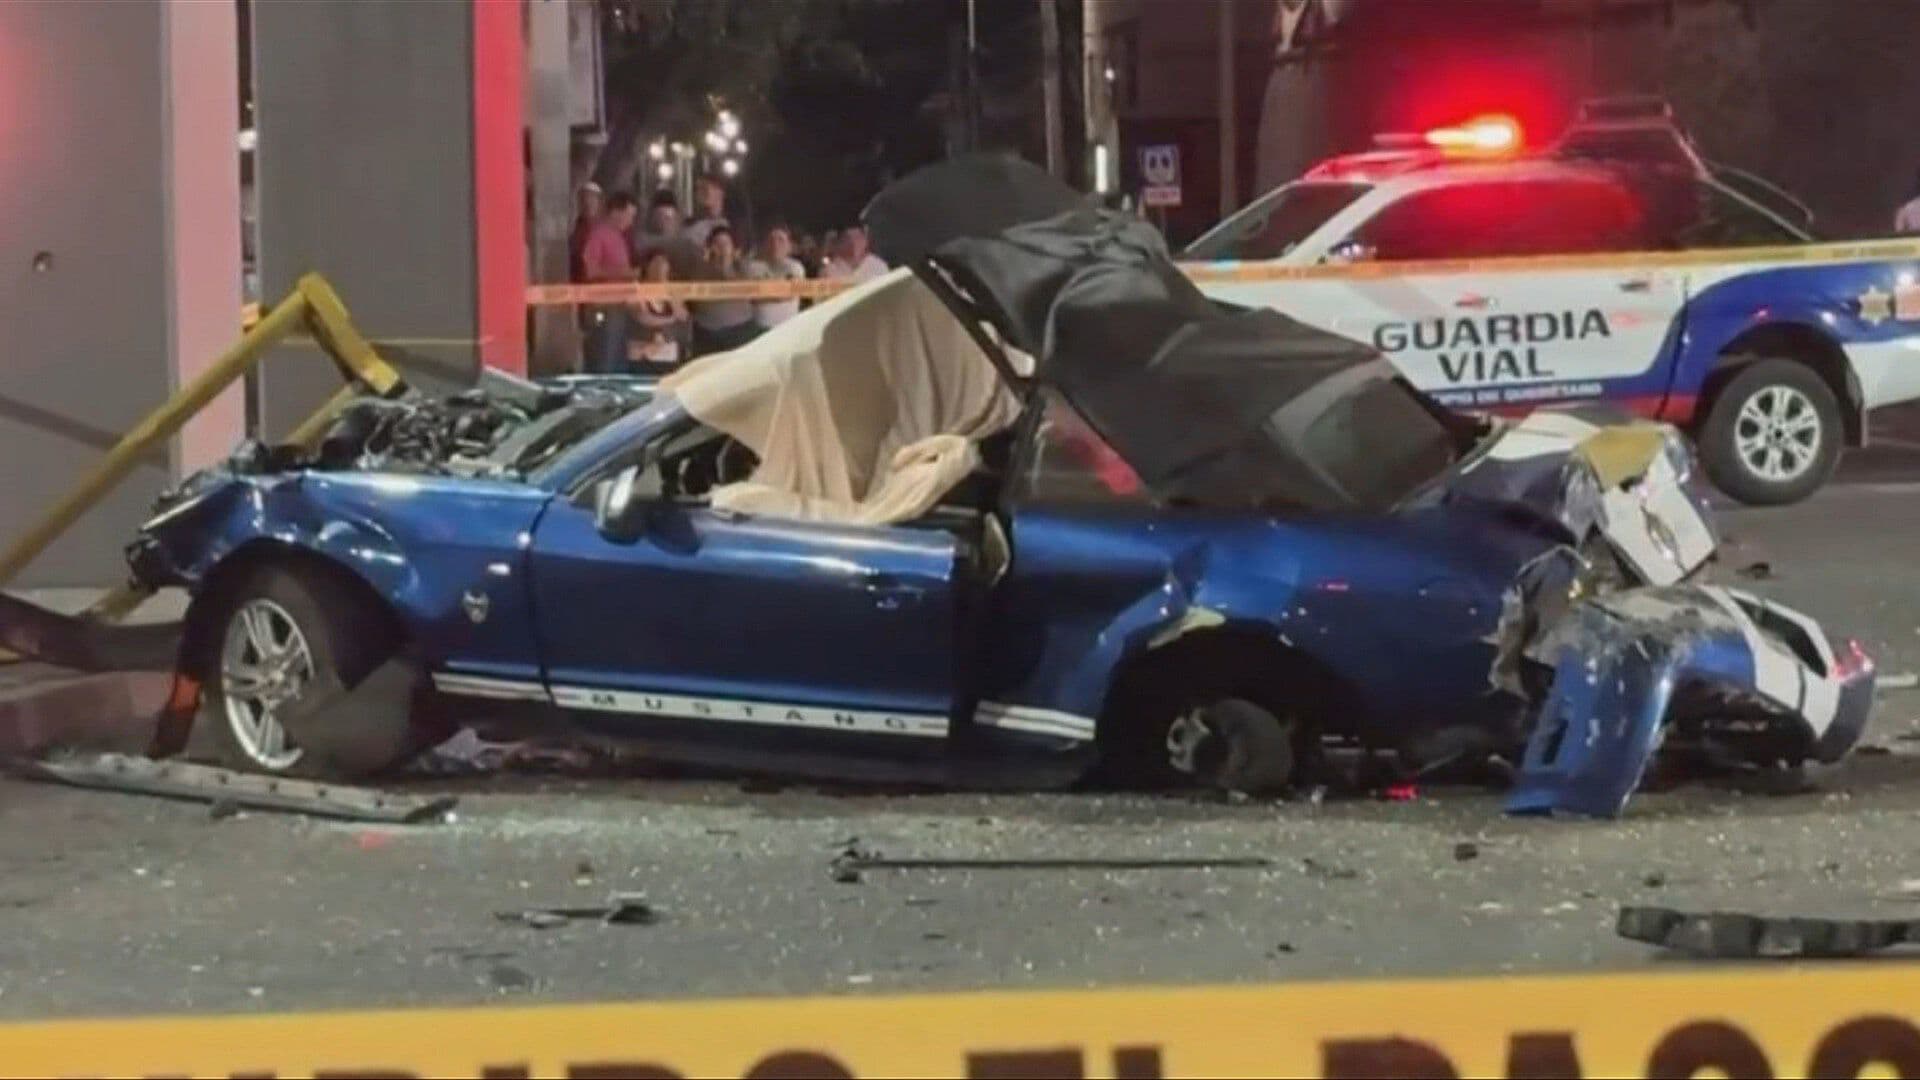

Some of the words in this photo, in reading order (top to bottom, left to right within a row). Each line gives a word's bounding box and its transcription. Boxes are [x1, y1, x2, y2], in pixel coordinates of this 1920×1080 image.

[1372, 308, 1611, 353] GUARDIA
[1437, 347, 1554, 383] VIAL
[591, 693, 907, 730] MUSTANG
